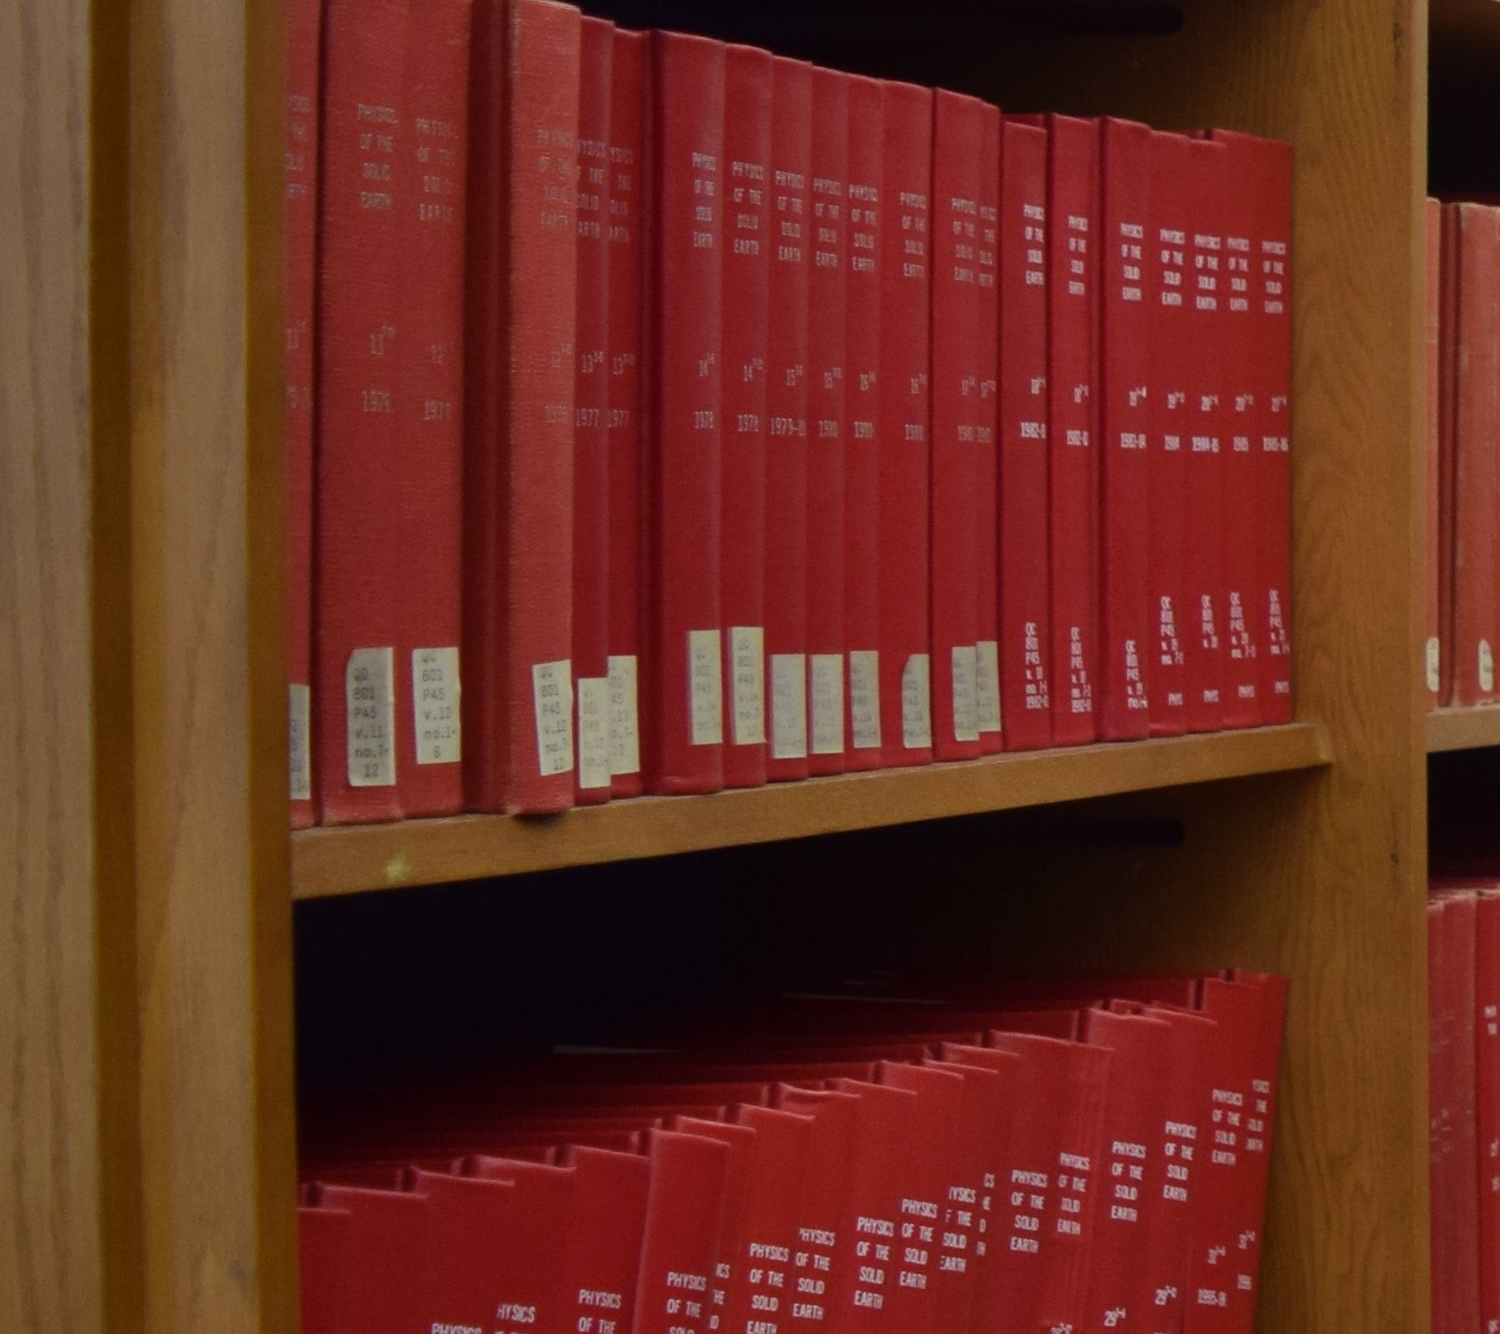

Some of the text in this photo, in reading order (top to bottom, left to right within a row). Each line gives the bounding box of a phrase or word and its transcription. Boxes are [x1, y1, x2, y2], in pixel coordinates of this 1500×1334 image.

[857, 1217, 894, 1237] PHYSICS
[750, 1243, 789, 1261] PHYSICS
[857, 1241, 890, 1261] OF THE
[667, 1271, 707, 1291] PHYSICS
[750, 1269, 784, 1288] OF THE
[579, 1289, 622, 1309] PHYSICS
[667, 1298, 701, 1318] OF THE
[752, 1295, 778, 1312] SOLID
[854, 1290, 883, 1309] EARTH
[578, 1316, 593, 1333] OF
